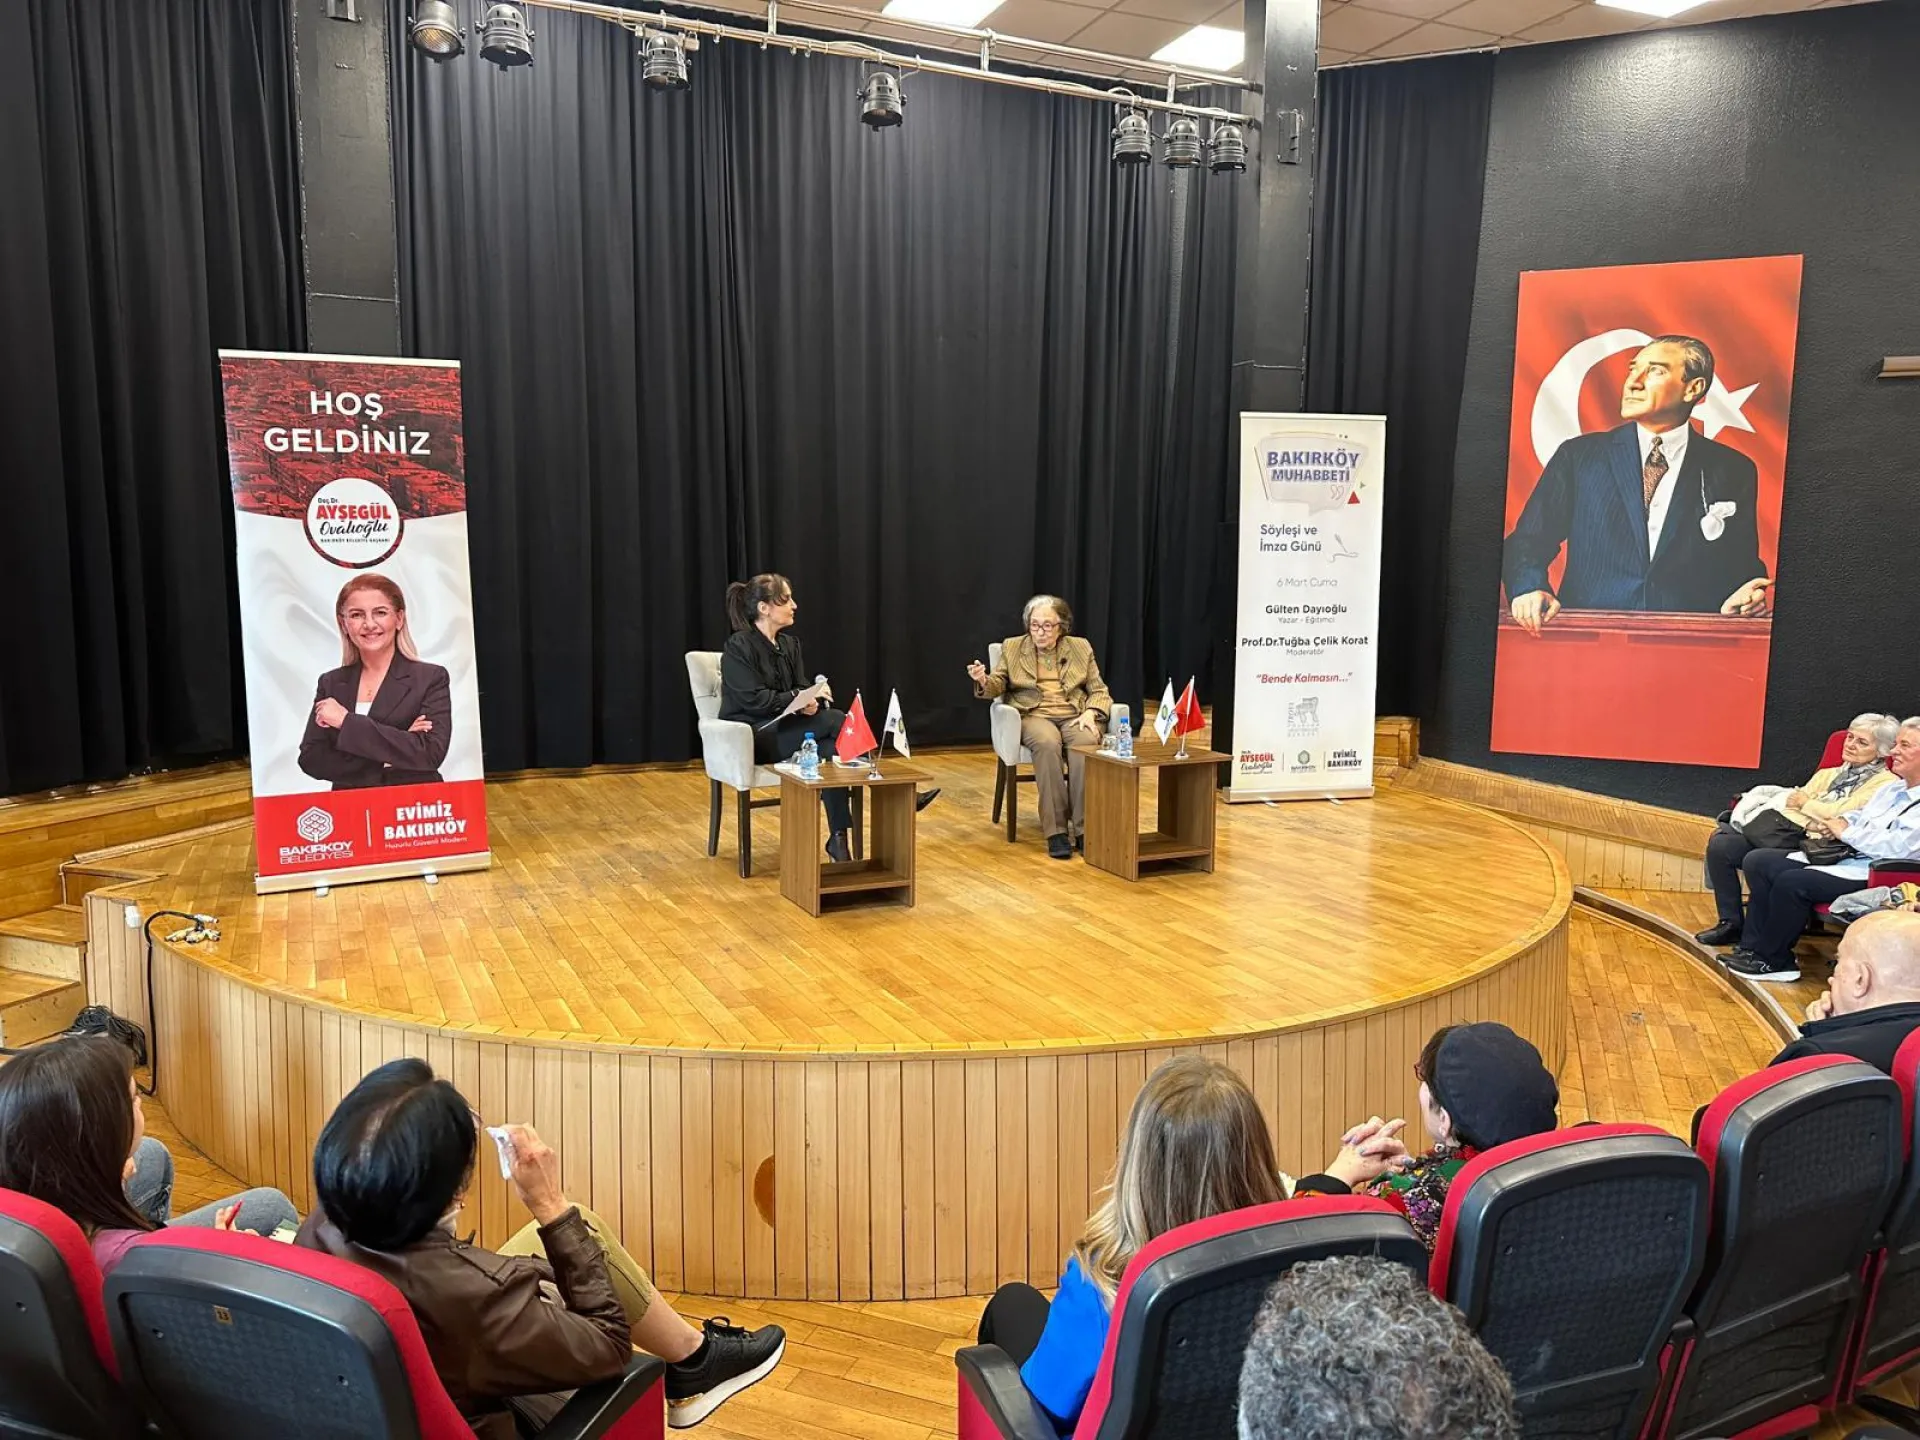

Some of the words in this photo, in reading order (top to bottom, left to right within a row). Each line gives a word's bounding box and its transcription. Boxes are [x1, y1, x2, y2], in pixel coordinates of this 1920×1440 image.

[310, 391, 384, 420] HOŞ
[264, 425, 431, 455] GELDİNİZ
[1266, 448, 1361, 468] BAKIRKÖY
[1271, 467, 1350, 482] MUHABBETİ
[316, 502, 391, 522] AYŞEGÜL
[319, 519, 388, 538] Ovalıoğlu
[1260, 524, 1301, 538] Söyleşi
[1303, 526, 1318, 535] ve
[1260, 539, 1287, 552] İmza
[1290, 541, 1322, 552] Günü
[1276, 579, 1284, 588] 6
[1286, 579, 1308, 588] Mart
[1310, 579, 1338, 588] Cuma
[1265, 604, 1300, 614] Gülten
[1302, 604, 1347, 615] Dayıoğlu
[1278, 616, 1298, 624] Yazar
[1313, 636, 1338, 647] Çelik
[1341, 636, 1369, 646] Korat
[1286, 648, 1324, 656] Moderatör
[1333, 749, 1357, 759] EVİMİZ
[1327, 758, 1363, 768] BAKIRKÖY
[396, 799, 452, 821] EVİMİZ
[384, 816, 466, 840] BAKIRKÖY
